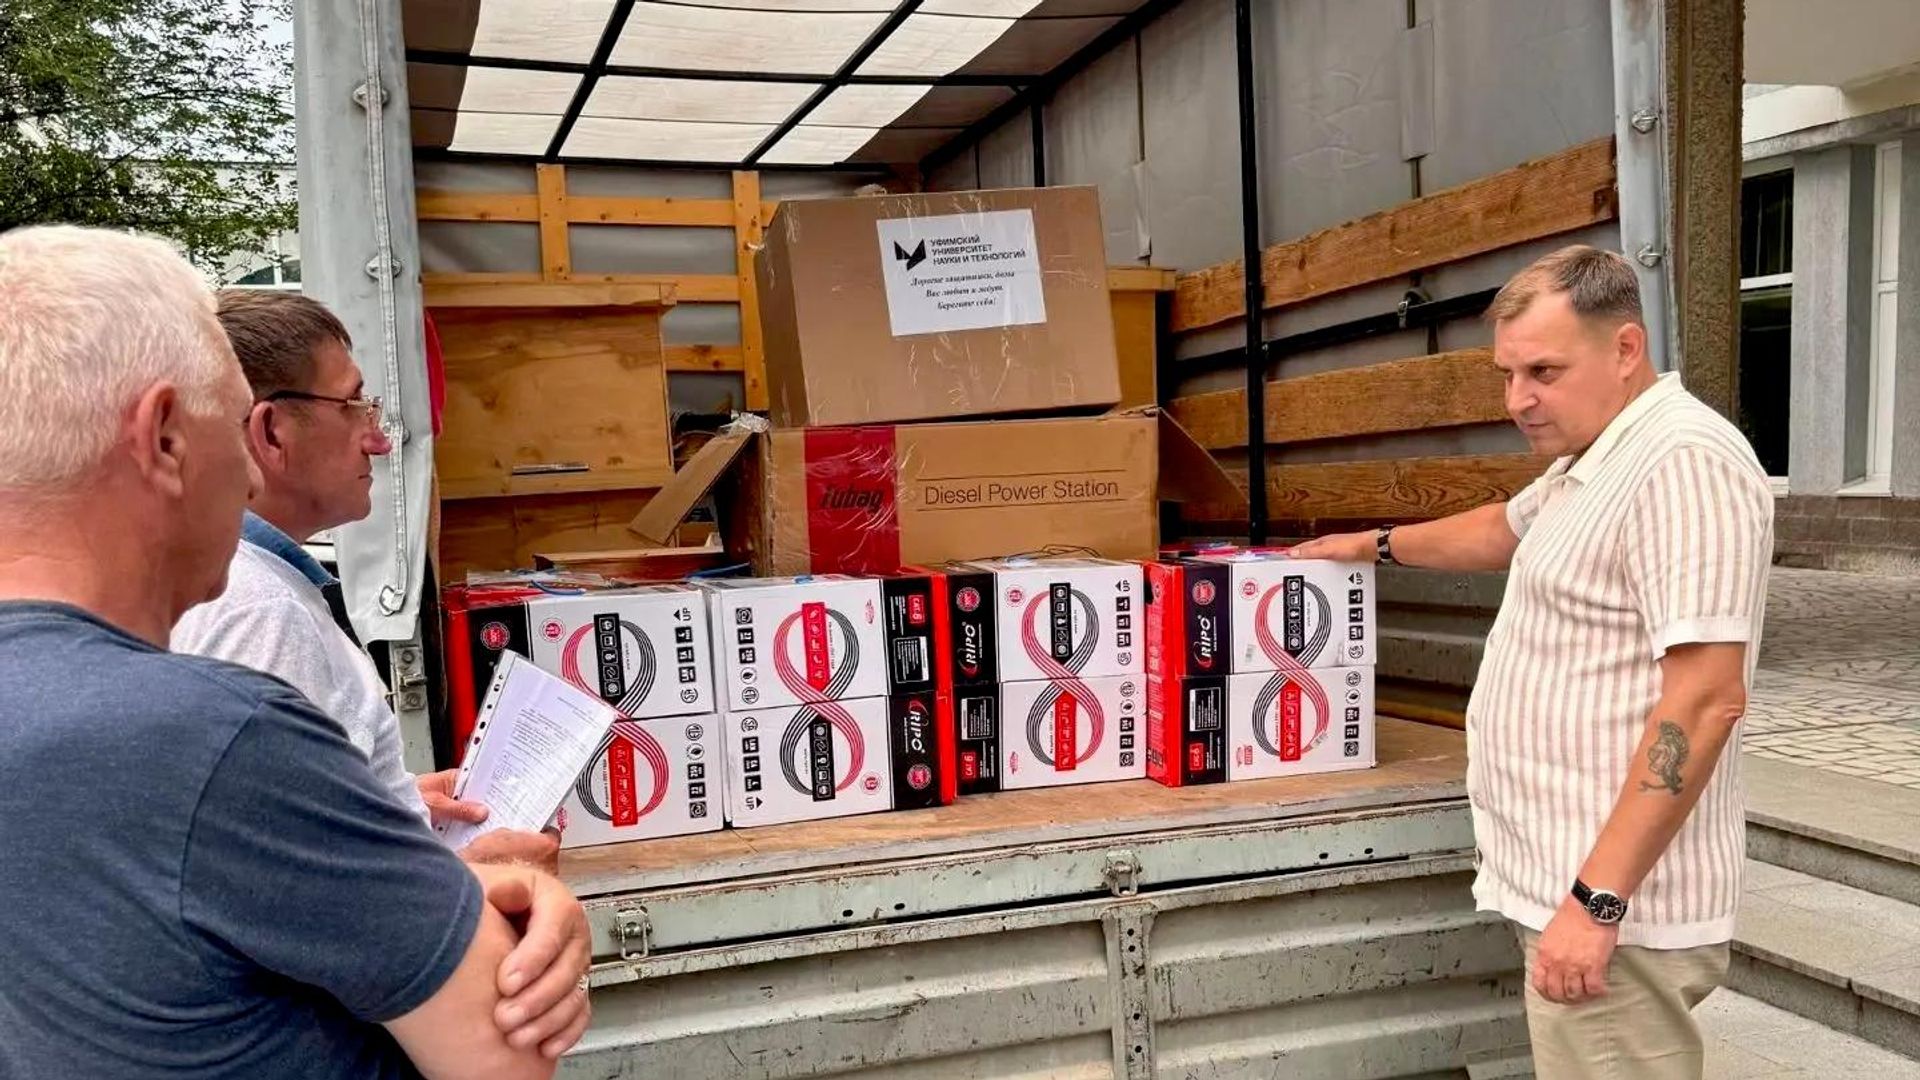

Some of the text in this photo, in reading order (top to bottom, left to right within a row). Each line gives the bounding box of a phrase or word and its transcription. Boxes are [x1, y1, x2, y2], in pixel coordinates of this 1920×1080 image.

[931, 234, 980, 247] УФИМСКИЙ
[932, 244, 992, 256] УНИВЕРСИТЕТ
[934, 248, 1025, 265] НАУКИ И ТЕХНОЛОГИЙ
[925, 479, 1119, 505] Diesel Power Station
[1356, 571, 1363, 585] UP
[1123, 580, 1130, 592] UP
[683, 607, 692, 621] UP
[965, 624, 977, 664] RIPO
[1200, 617, 1211, 657] RIPO
[910, 710, 923, 751] RIPO
[745, 797, 755, 810] UP
